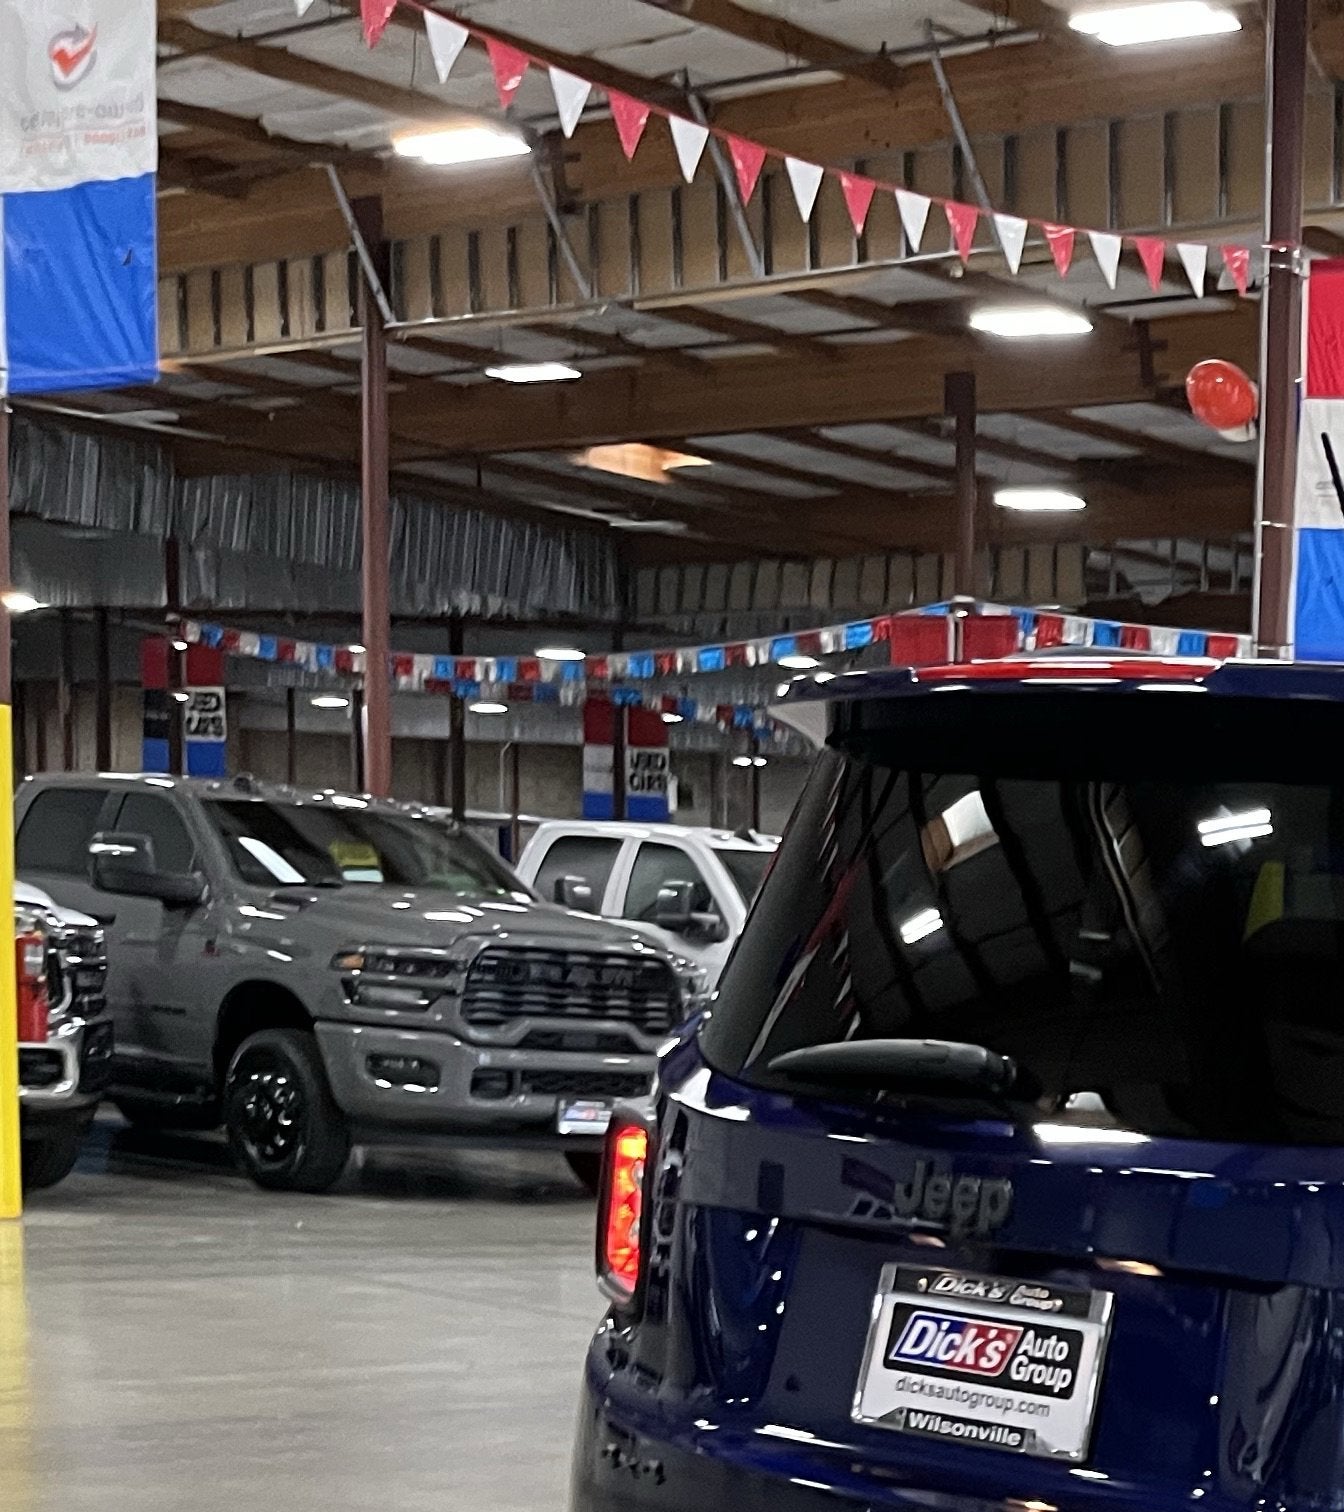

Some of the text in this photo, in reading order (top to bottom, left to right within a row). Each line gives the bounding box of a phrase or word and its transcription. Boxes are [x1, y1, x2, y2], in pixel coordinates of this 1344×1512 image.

[894, 1160, 1013, 1233] Jeep
[935, 1274, 1007, 1300] Dick's
[899, 1319, 1069, 1369] Dick's Auto
[1010, 1354, 1072, 1393] Group
[895, 1376, 1051, 1418] dicksautogroup.com
[908, 1410, 1022, 1447] Wilsonville
